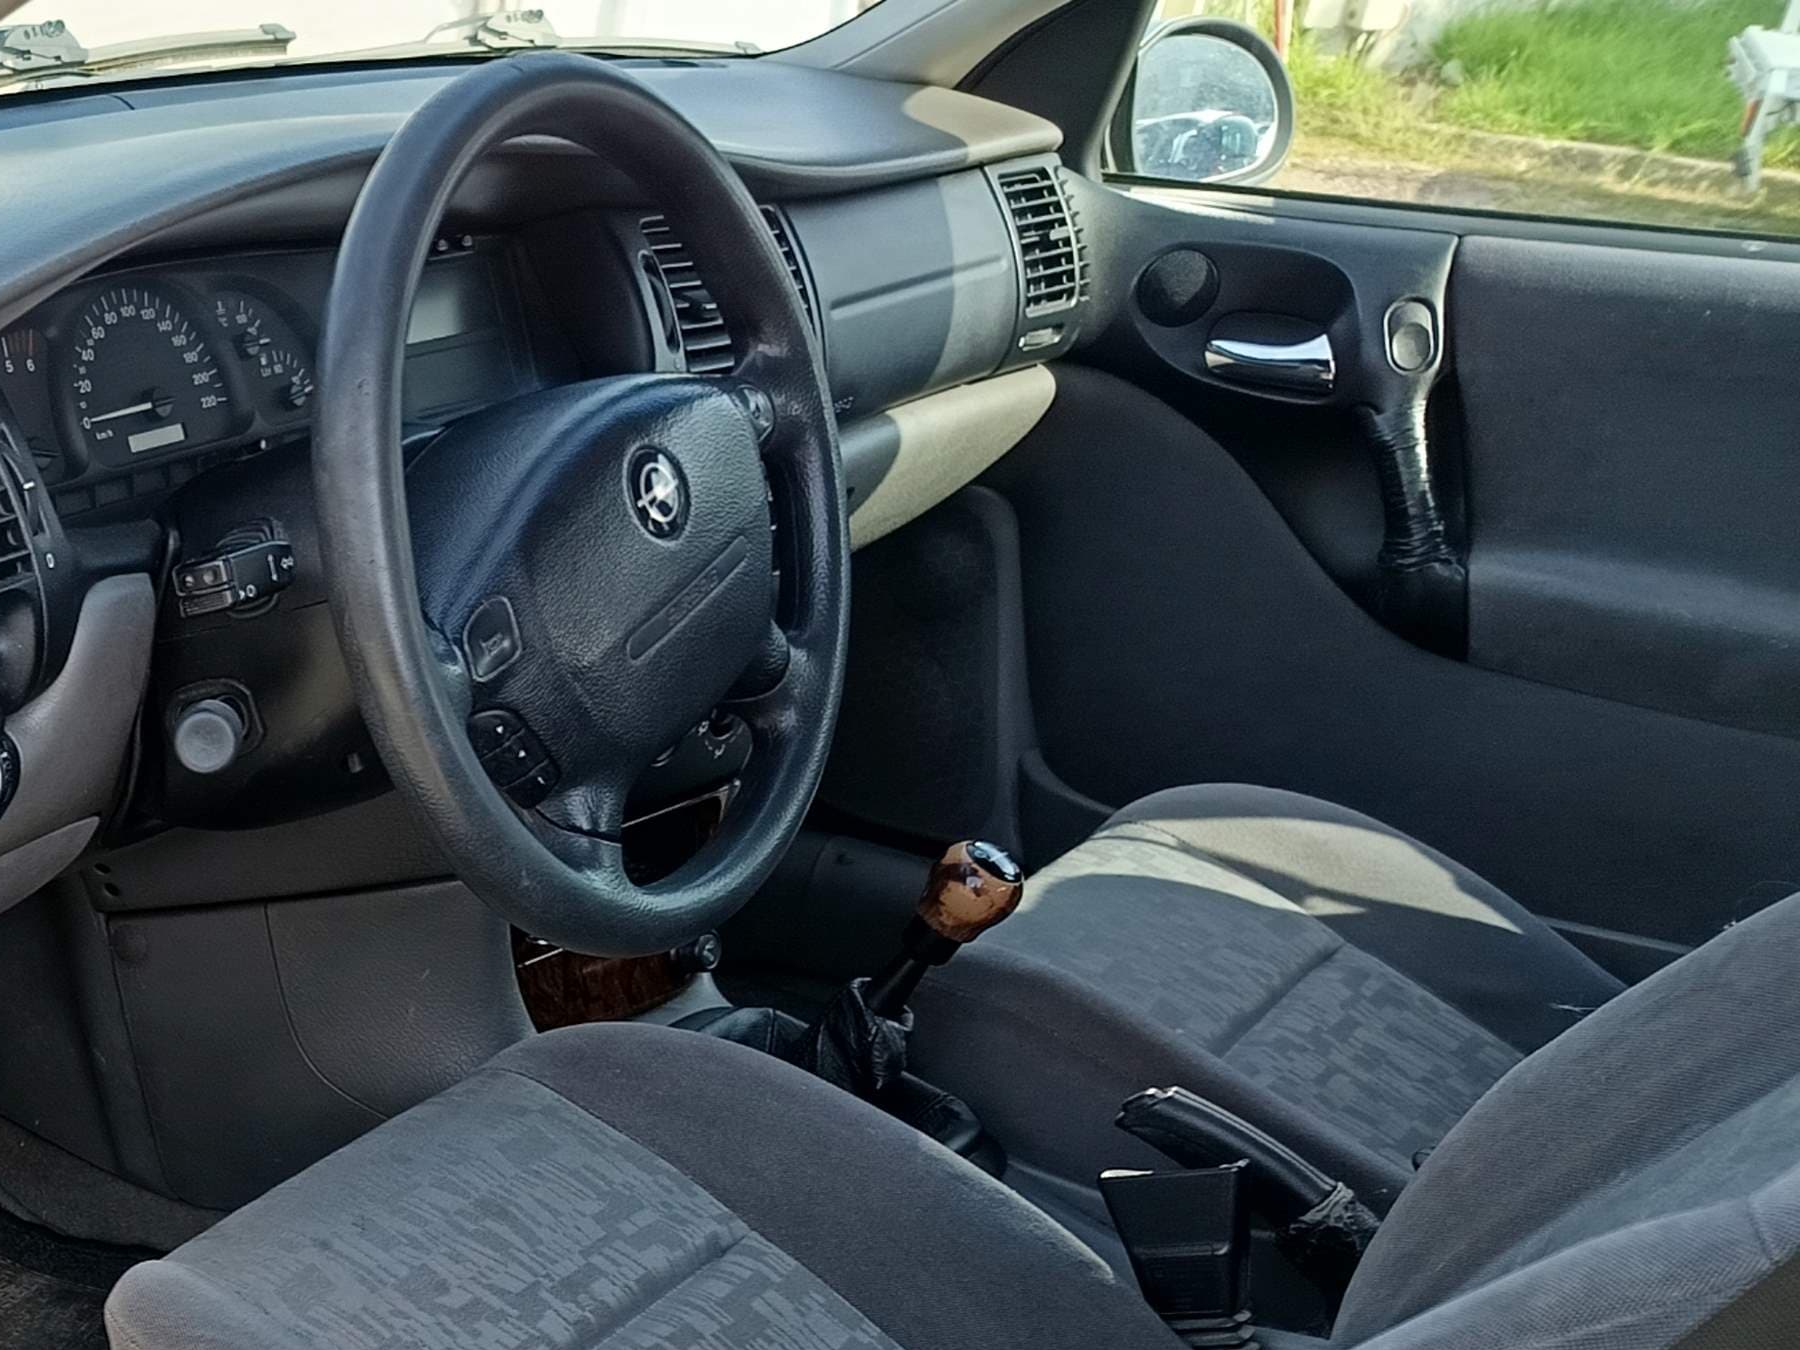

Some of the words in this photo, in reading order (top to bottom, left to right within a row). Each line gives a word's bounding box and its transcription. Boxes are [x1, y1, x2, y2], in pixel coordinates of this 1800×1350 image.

[120, 304, 136, 317] 100
[140, 307, 156, 320] 120
[104, 311, 118, 325] 80
[91, 326, 105, 340] 60
[156, 320, 173, 333] 140
[81, 348, 95, 361] 40
[183, 351, 199, 363] 180
[5, 359, 14, 373] 5
[26, 358, 35, 372] 6
[192, 371, 210, 386] 200
[79, 379, 92, 393] 20
[200, 394, 217, 408] 220
[82, 416, 91, 430] 0
